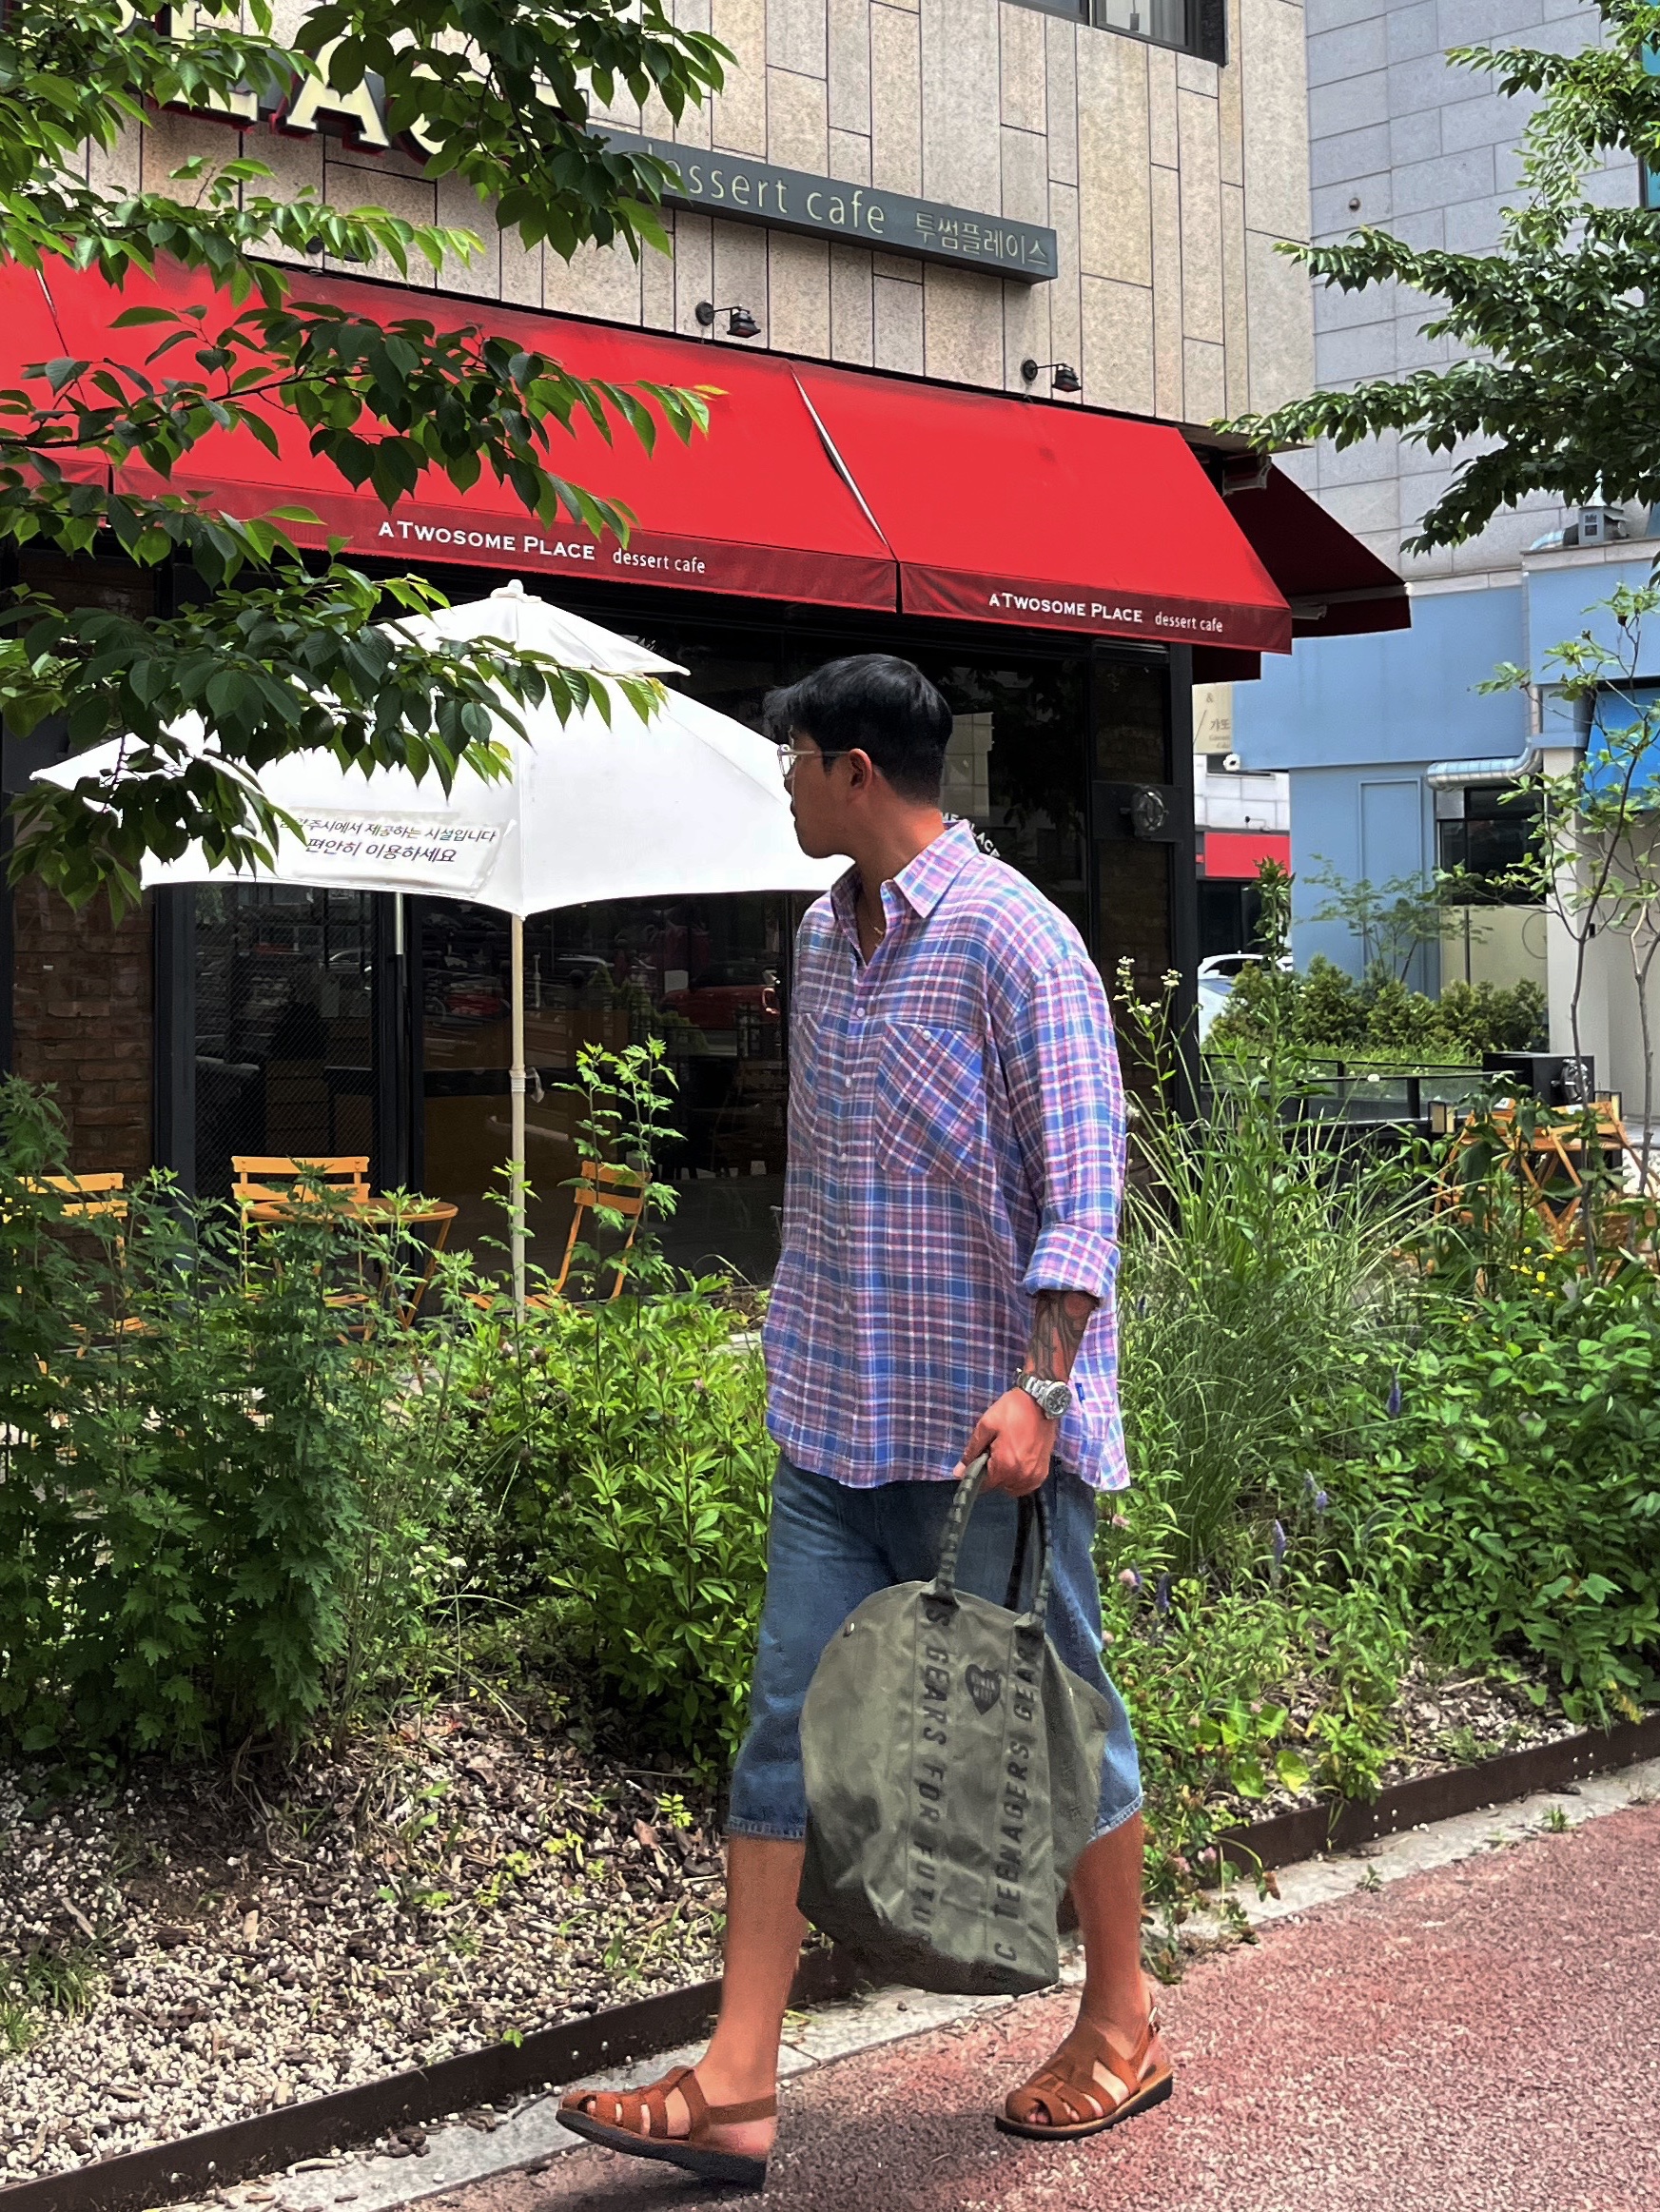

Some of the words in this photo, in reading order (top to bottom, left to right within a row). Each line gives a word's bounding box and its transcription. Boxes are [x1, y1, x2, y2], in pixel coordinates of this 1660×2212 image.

[806, 188, 886, 234] cafe
[914, 211, 1048, 266] 투썸플레이스
[378, 520, 395, 538] A
[396, 519, 517, 551] TWOSOME
[523, 536, 596, 560] PLACE
[612, 547, 670, 570] dessert
[674, 558, 706, 574] cafe
[988, 593, 1000, 607] A
[1002, 592, 1086, 617] TWOSOME
[1091, 602, 1142, 623] PLACE
[1154, 611, 1197, 631] dessert
[1200, 618, 1223, 633] cafe
[305, 838, 362, 856] 편안히
[365, 844, 457, 863] 이용하세요
[364, 823, 421, 839] 제공하는
[424, 827, 497, 843] 시설입니다
[924, 1645, 949, 1746] GEARS
[918, 1762, 946, 1825] FOR
